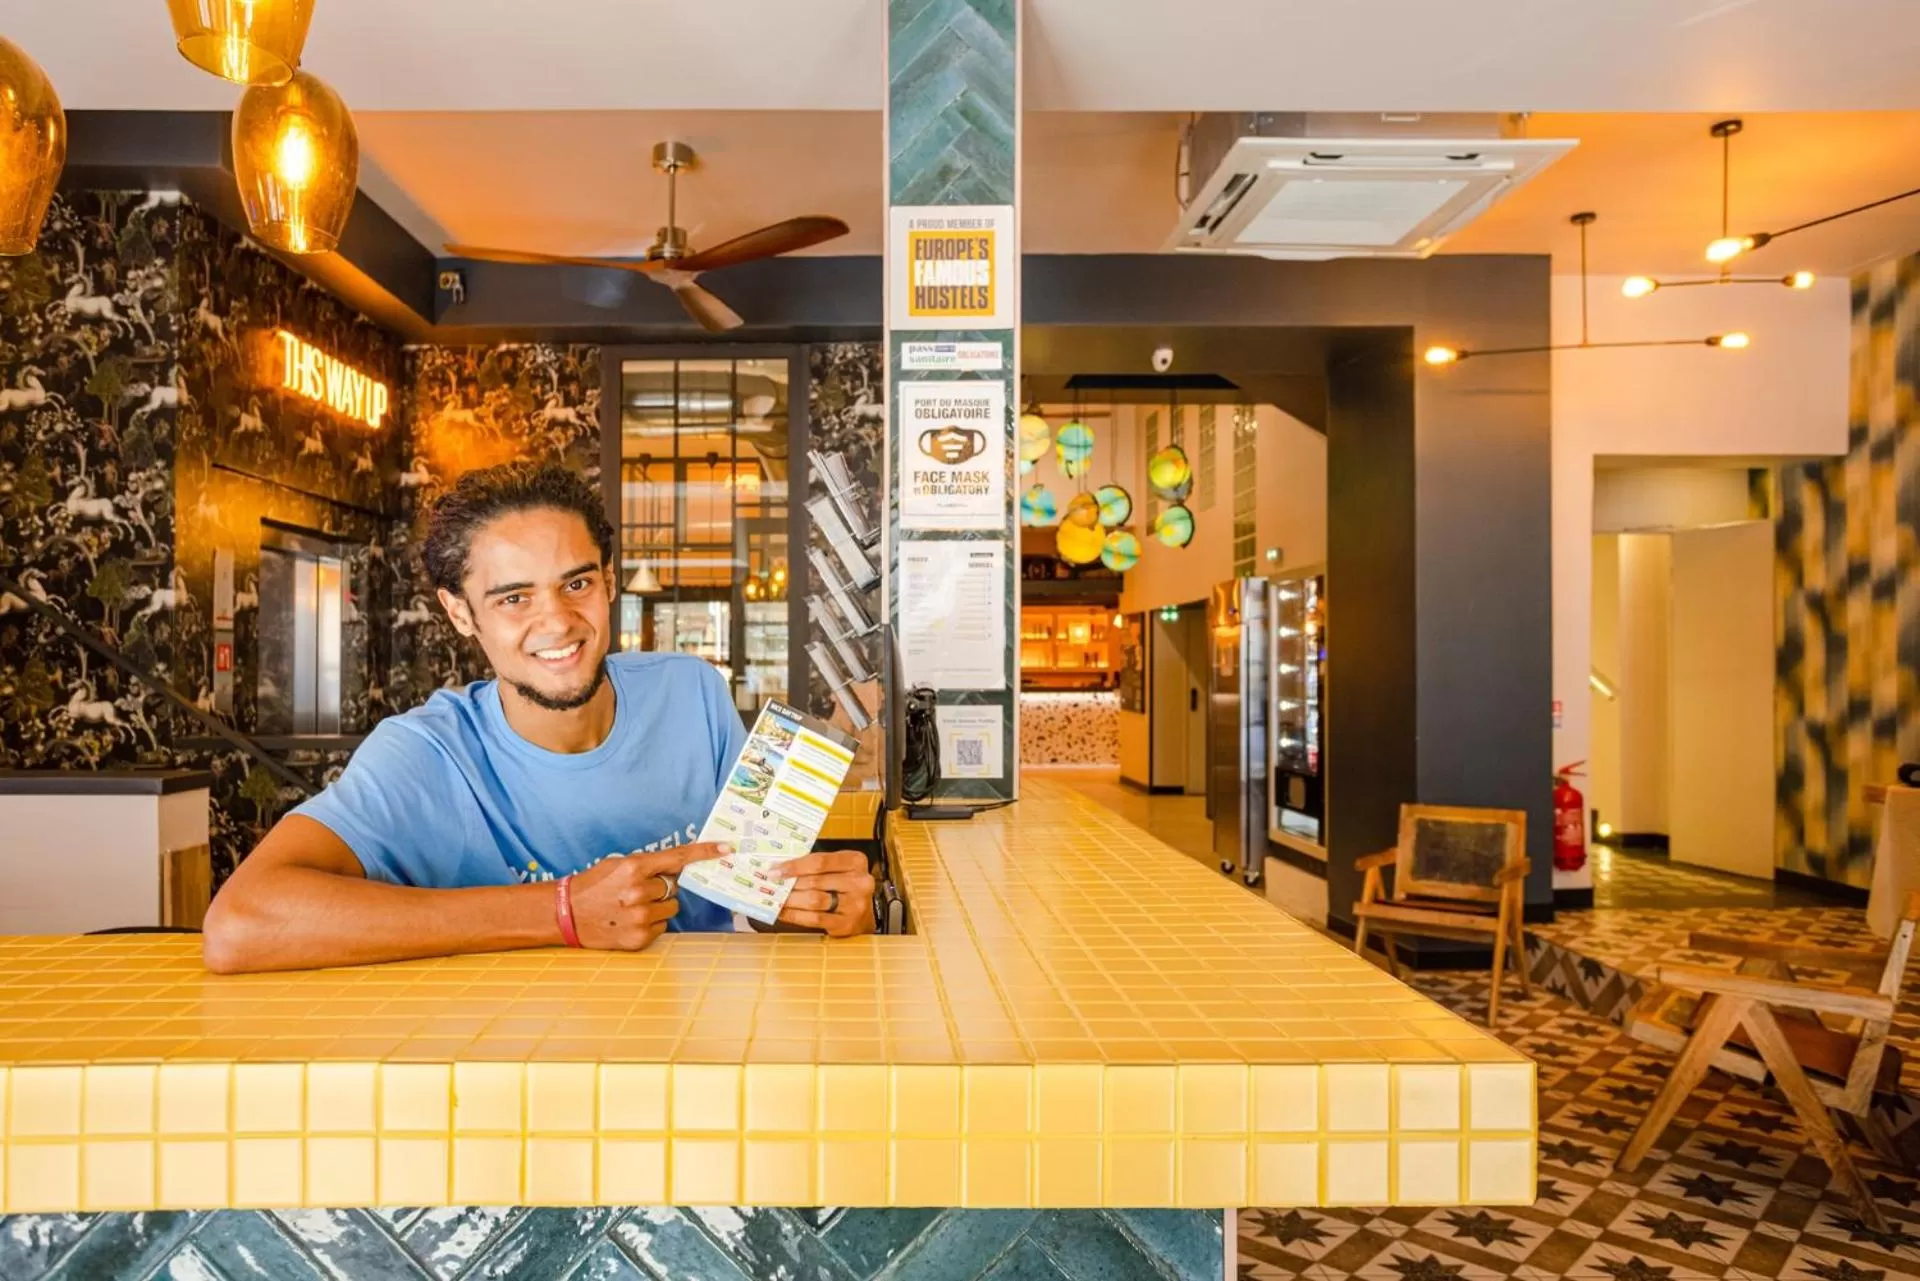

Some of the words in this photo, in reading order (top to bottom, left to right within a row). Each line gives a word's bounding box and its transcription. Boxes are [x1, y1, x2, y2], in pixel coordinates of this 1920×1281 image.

[947, 218, 981, 229] MEMBER
[915, 238, 989, 260] EUROPE'S
[915, 285, 989, 310] HOSTELS
[323, 353, 365, 420] WAY
[365, 376, 388, 429] UP
[914, 398, 937, 407] PORT
[939, 398, 952, 407] DU
[954, 398, 991, 407] MASQUE
[914, 407, 991, 420] OBLIGATOIRE
[913, 470, 947, 484] FACE
[951, 470, 990, 484] MASK
[922, 484, 990, 496] OBLIGATORY
